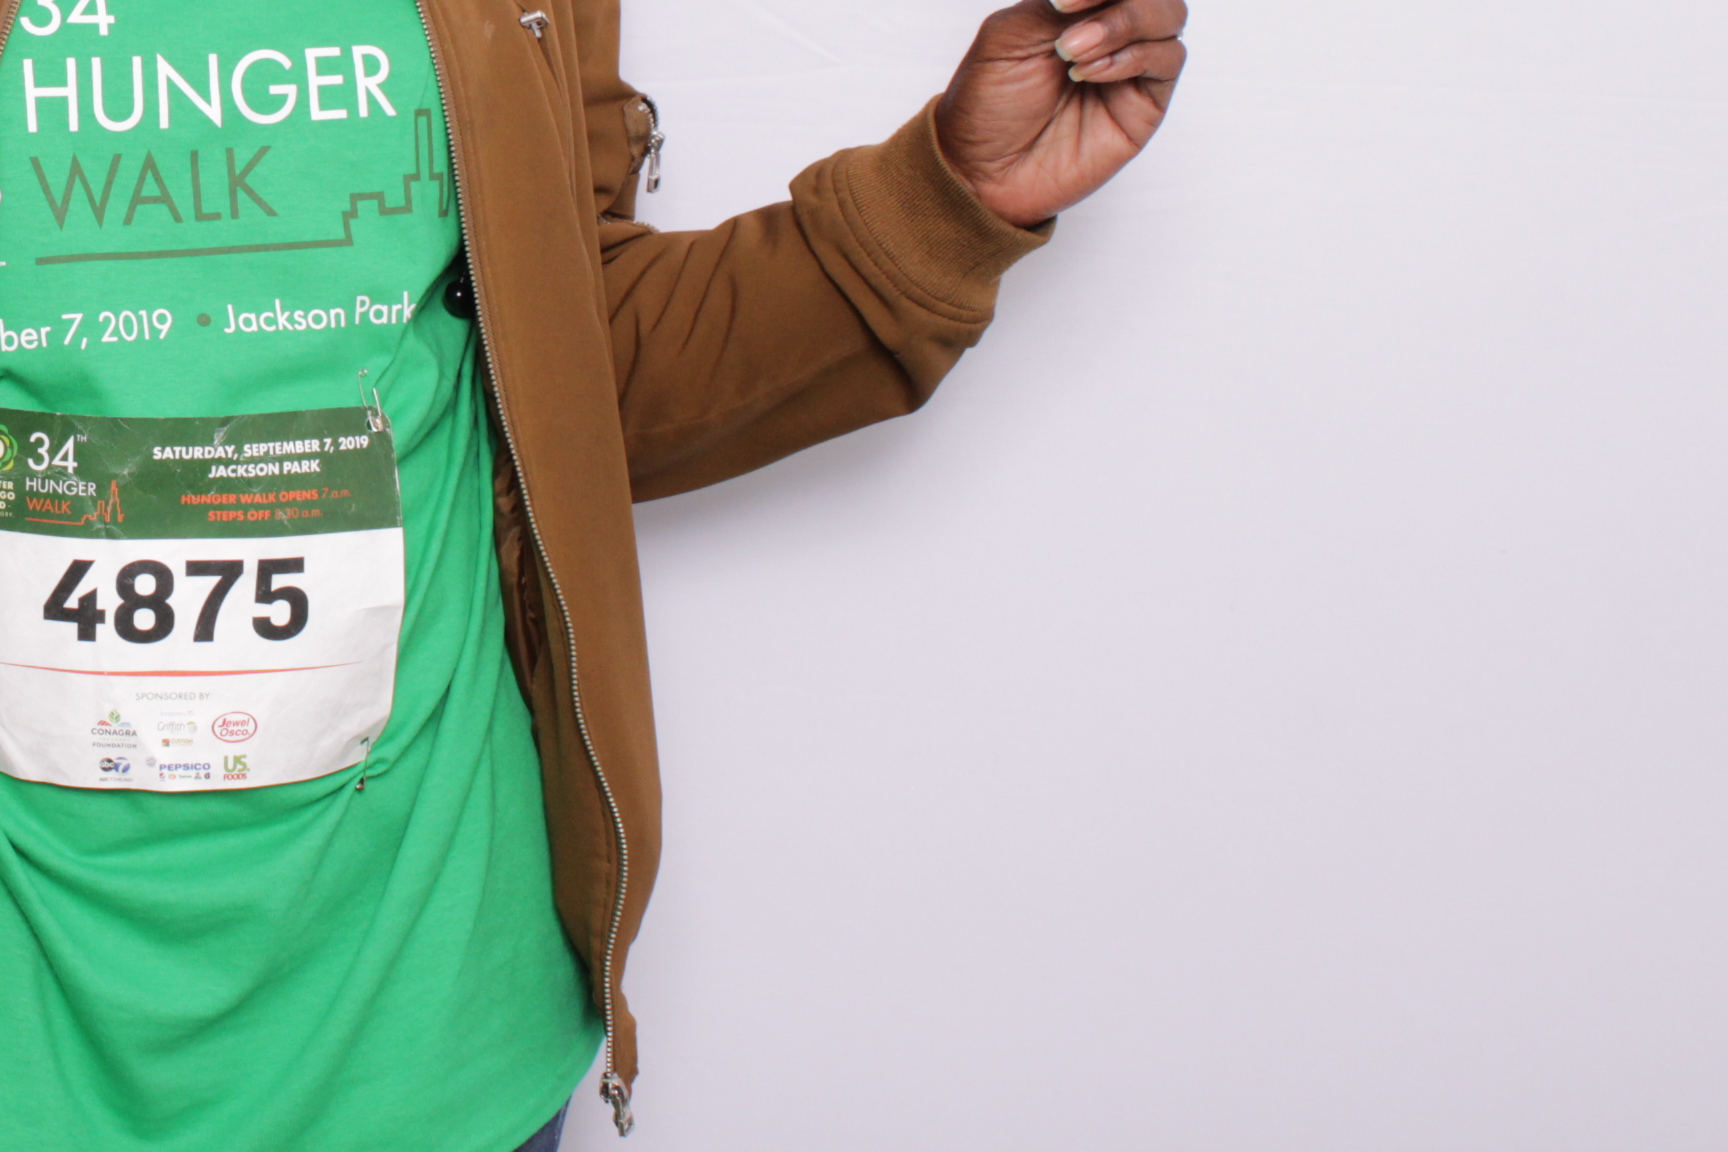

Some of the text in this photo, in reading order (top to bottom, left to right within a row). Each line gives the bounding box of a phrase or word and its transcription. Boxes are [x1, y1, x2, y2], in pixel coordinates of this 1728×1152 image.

[22, 45, 397, 133] HUNGER
[29, 145, 279, 230] WALK
[224, 291, 418, 333] Jackson Park
[61, 313, 88, 349] 7,
[98, 308, 173, 342] 2019
[152, 435, 370, 461] SATURDAY, SEPTEMBER 7, 2019
[208, 459, 321, 478] JACKSON PARK
[25, 477, 97, 496] HUNGER
[180, 492, 237, 505] HUNGER
[239, 490, 277, 504] WALK
[279, 489, 319, 503] OPENS
[321, 487, 330, 499] 7
[26, 496, 72, 515] WALK
[207, 510, 245, 522] STEPS
[247, 509, 272, 521] OFF
[302, 509, 324, 518] a.m.
[42, 557, 309, 644] 4875
[135, 691, 197, 701] SPONSORED
[91, 727, 138, 737] CONAGRA
[218, 718, 250, 728] Jewel
[159, 762, 211, 772] PEPSICO
[223, 772, 248, 781] FOODS
